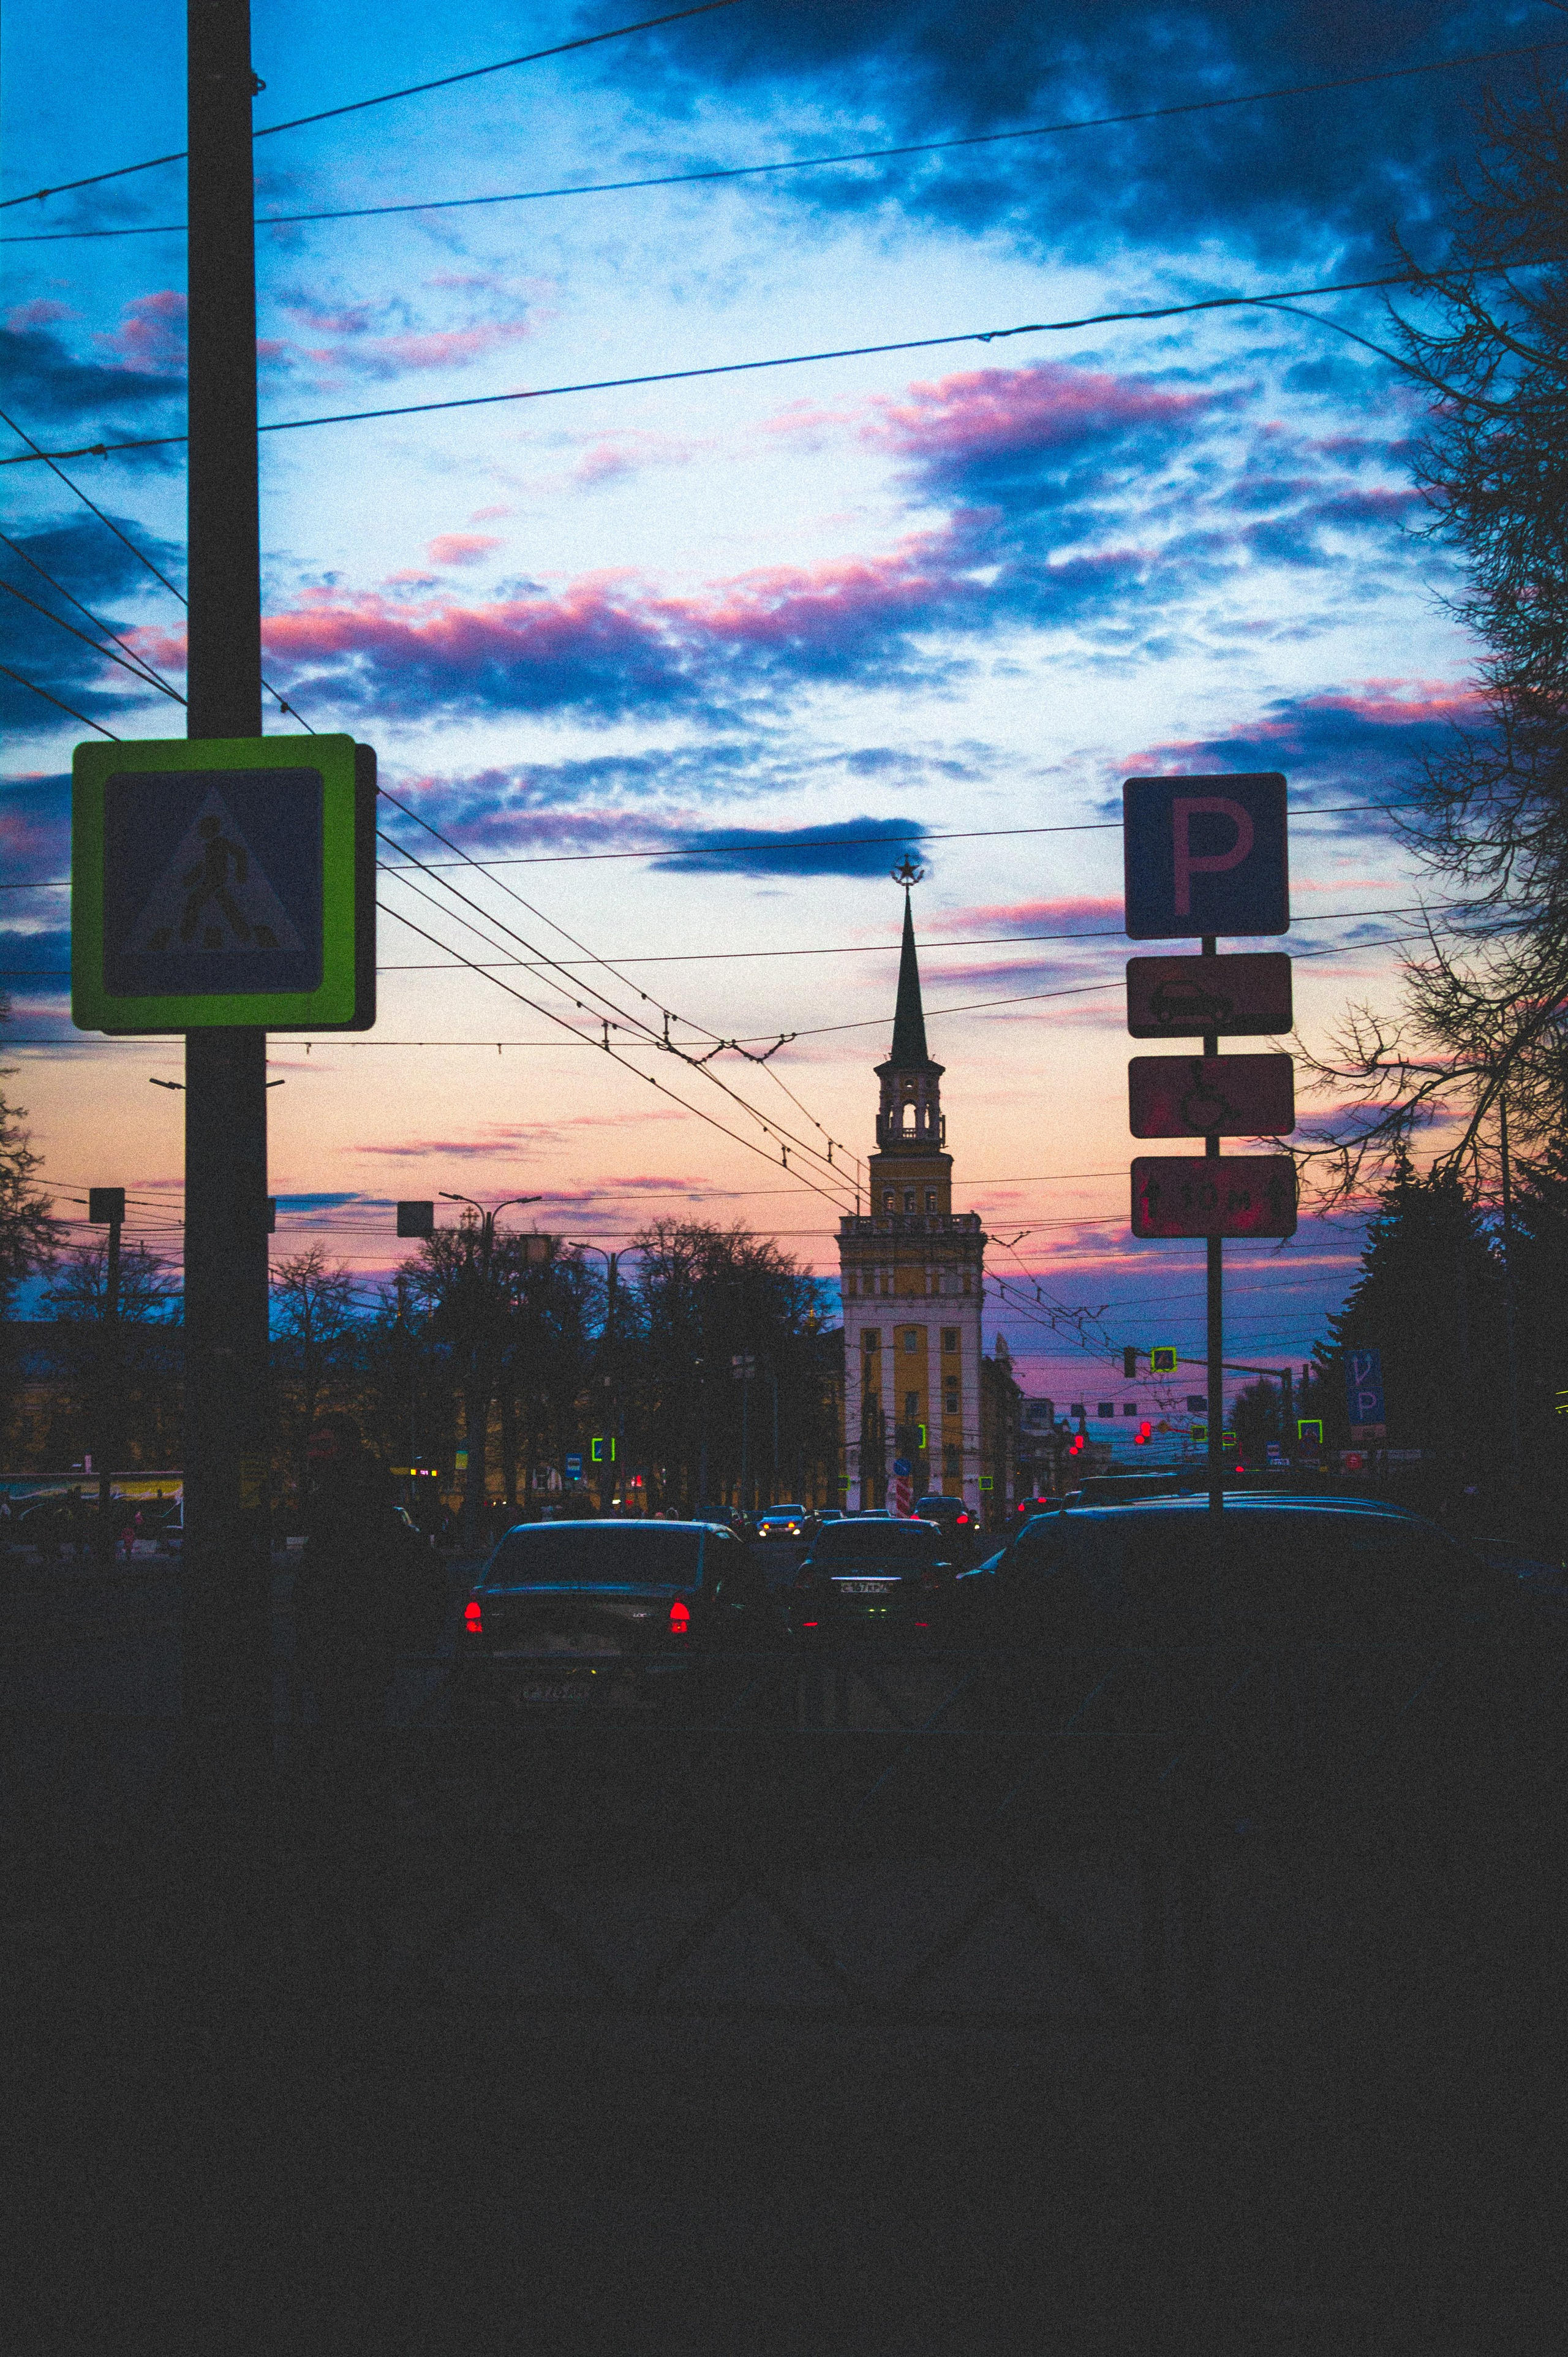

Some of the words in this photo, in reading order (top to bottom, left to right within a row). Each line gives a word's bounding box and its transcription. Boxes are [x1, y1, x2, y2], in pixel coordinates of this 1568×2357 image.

[1172, 796, 1254, 916] P
[1180, 1182, 1218, 1211] 10
[1358, 1391, 1377, 1420] P
